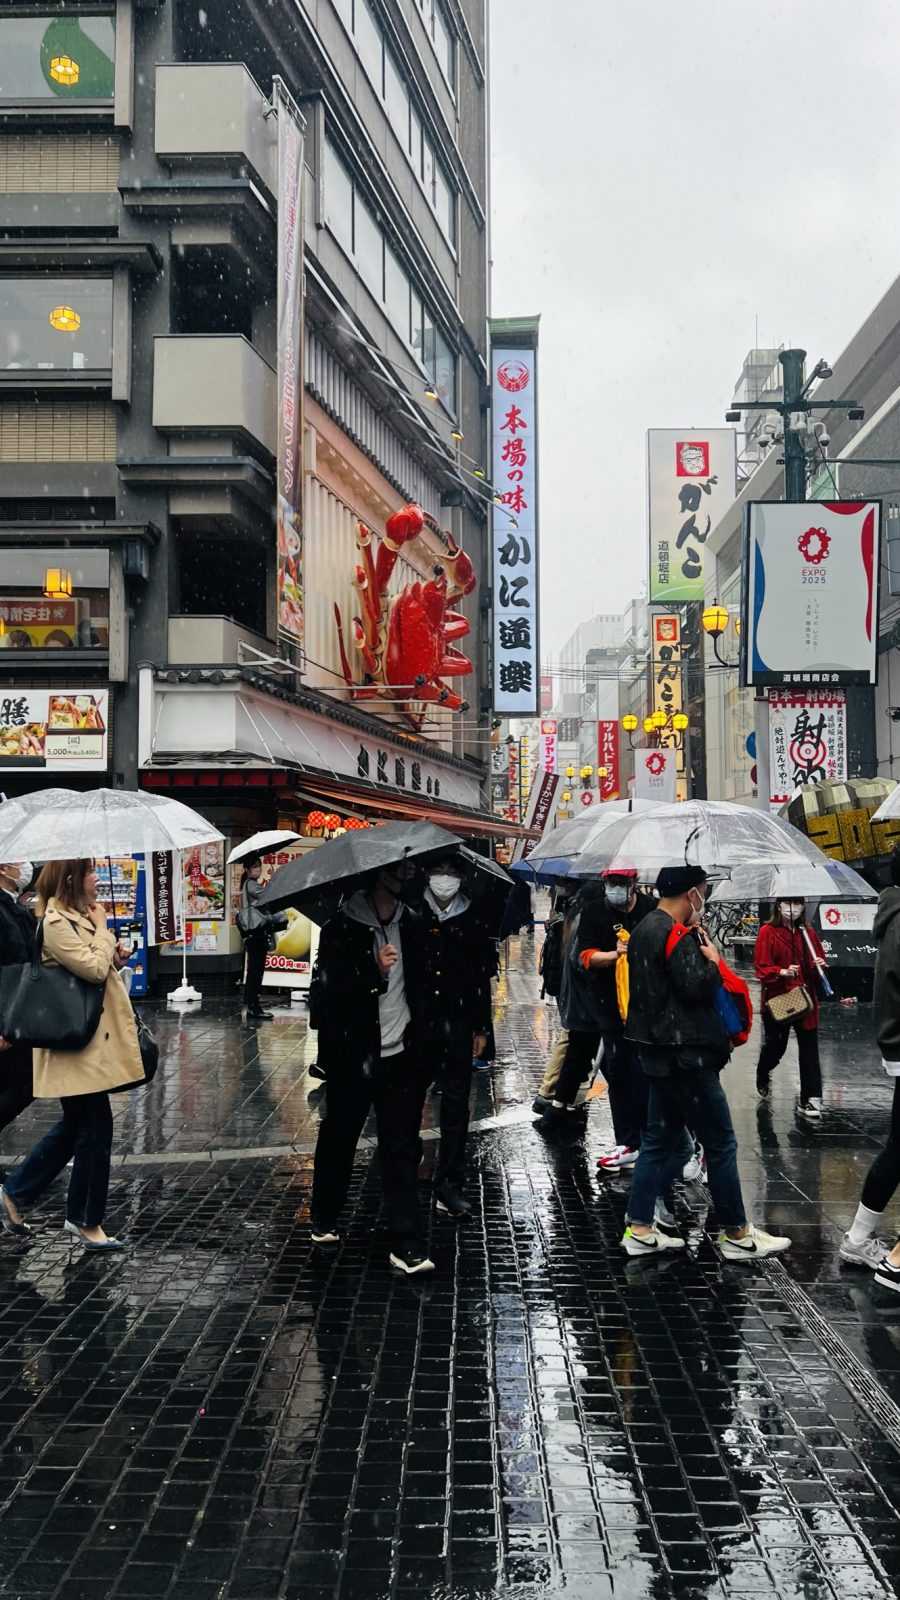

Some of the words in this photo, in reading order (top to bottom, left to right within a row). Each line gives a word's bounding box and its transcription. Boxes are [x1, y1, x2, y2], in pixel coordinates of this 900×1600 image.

[500, 404, 528, 514] 本場の味
[675, 475, 719, 579] がんこ
[802, 569, 826, 577] EXPO
[602, 722, 616, 792] ツルハドラッグ
